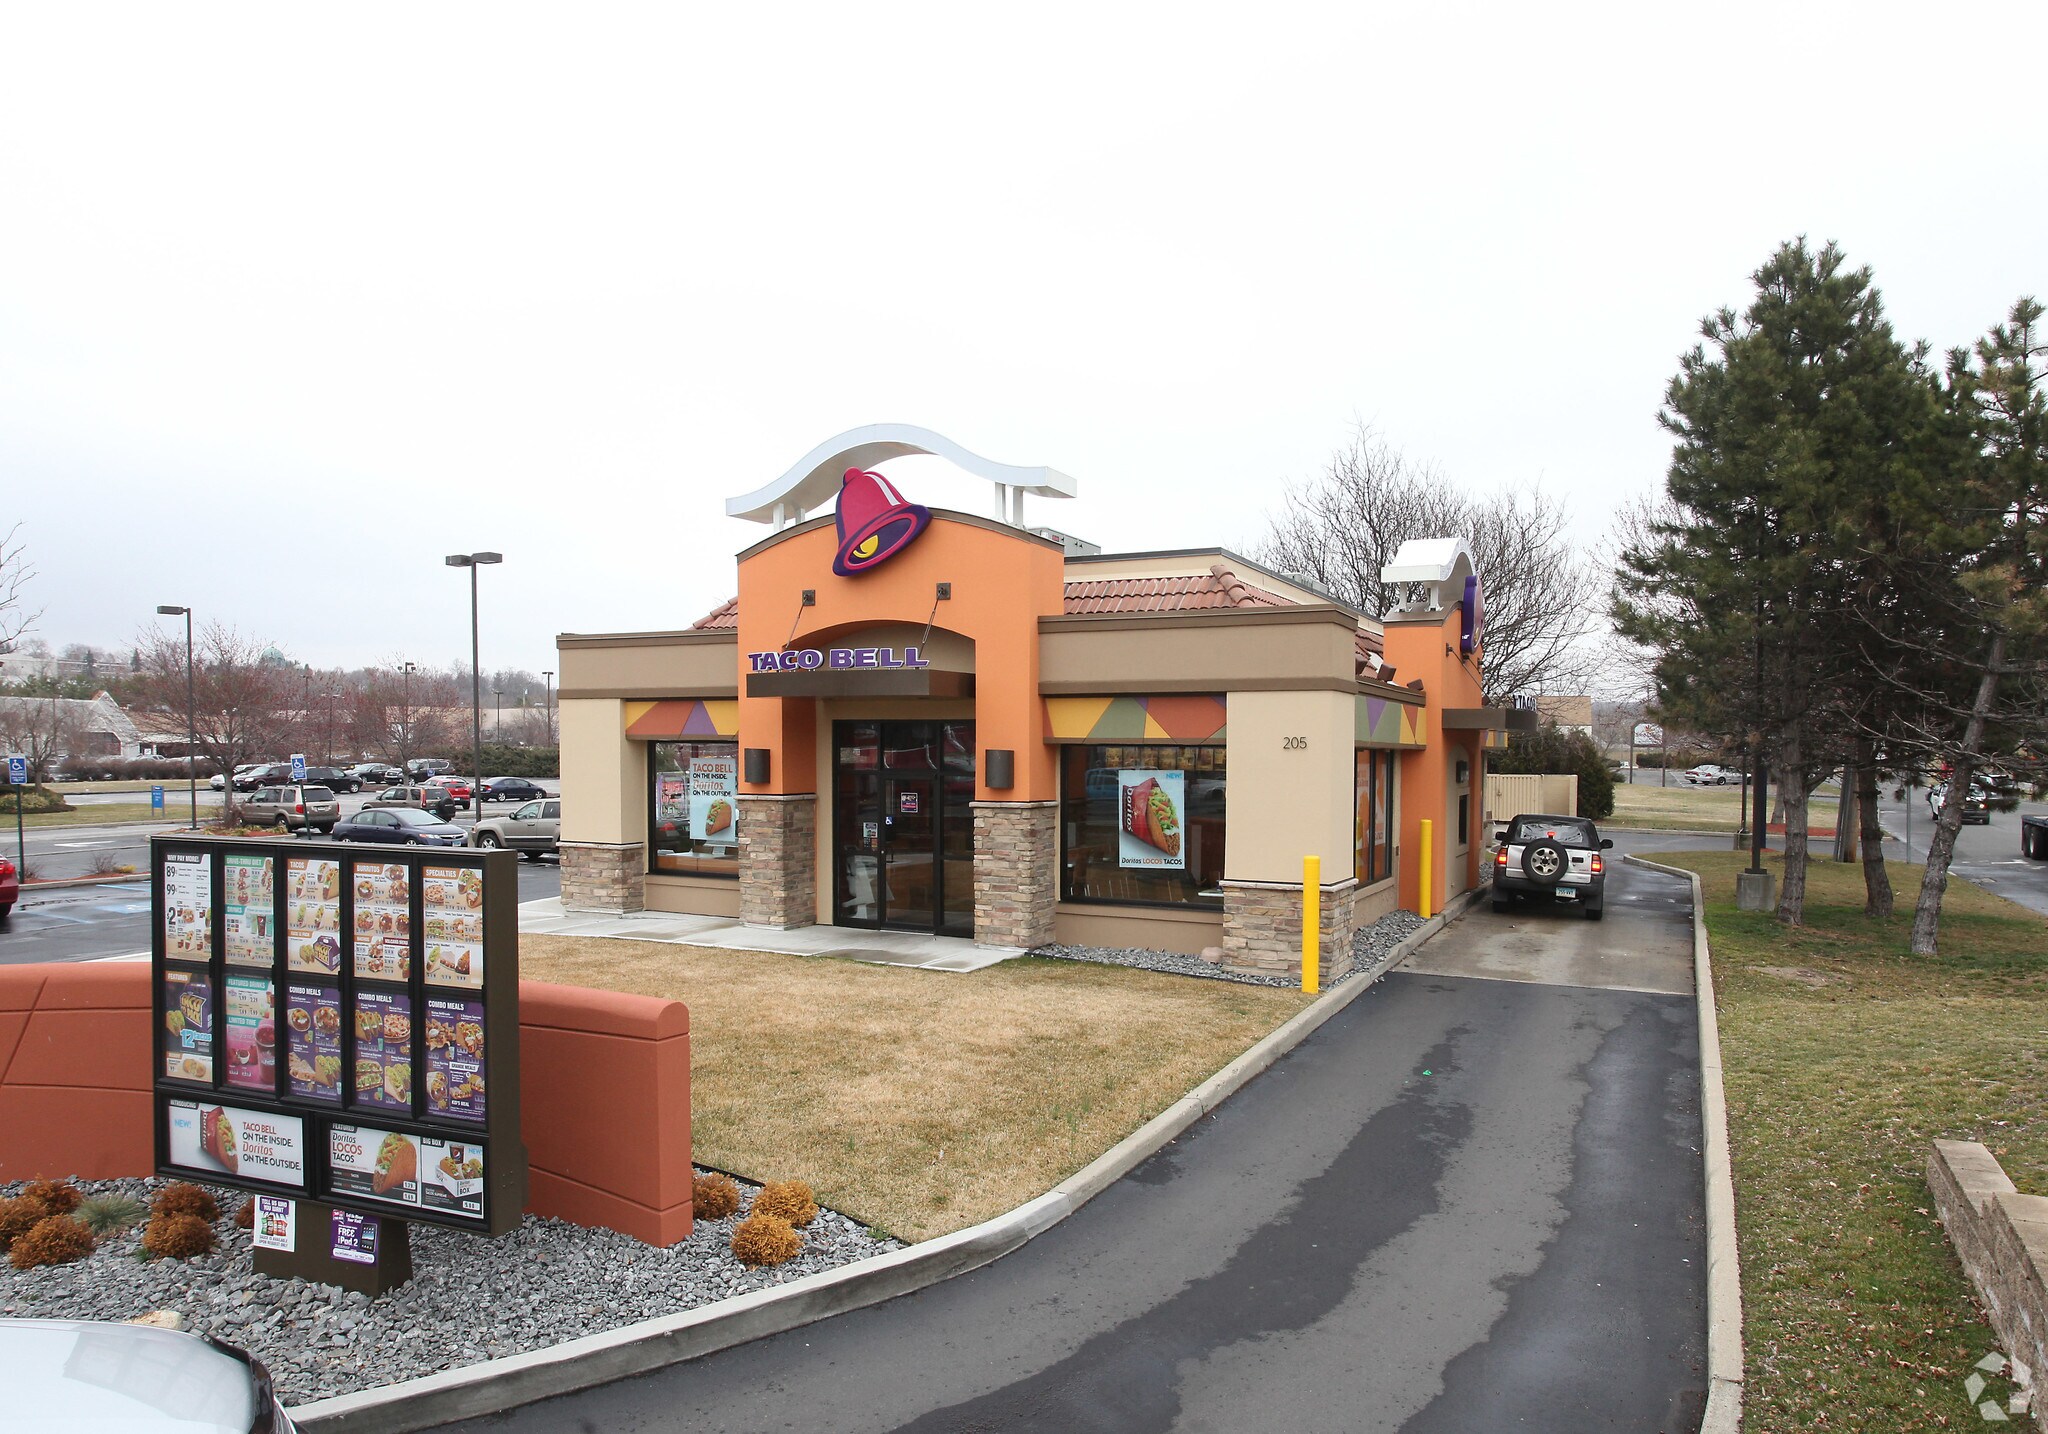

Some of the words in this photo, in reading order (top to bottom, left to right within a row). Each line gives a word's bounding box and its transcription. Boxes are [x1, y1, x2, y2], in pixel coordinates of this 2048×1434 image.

[748, 649, 824, 672] TACO
[830, 648, 930, 668] BELL
[1283, 736, 1307, 749] 205
[693, 764, 713, 772] TACO
[715, 764, 733, 773] BELL
[693, 780, 723, 790] Doritos
[426, 869, 456, 877] SPECIALTIES
[358, 993, 375, 1001] COMBO
[376, 995, 392, 1003] MEALS
[181, 1029, 195, 1048] 12
[243, 1122, 260, 1132] TACO
[261, 1123, 276, 1134] BELL
[243, 1132, 254, 1140] ON
[255, 1133, 268, 1143] THE
[269, 1135, 293, 1147] INSIDE.
[333, 1133, 356, 1143] Doritos
[243, 1141, 273, 1155] Doritos
[333, 1141, 362, 1155] LOCOS
[243, 1154, 255, 1162] ON
[256, 1155, 268, 1165] THE
[270, 1158, 301, 1170] OUTSIDE.
[333, 1152, 354, 1163] TACOS
[338, 1227, 355, 1237] FREE
[338, 1236, 352, 1246] iPad
[354, 1239, 358, 1247] 2
